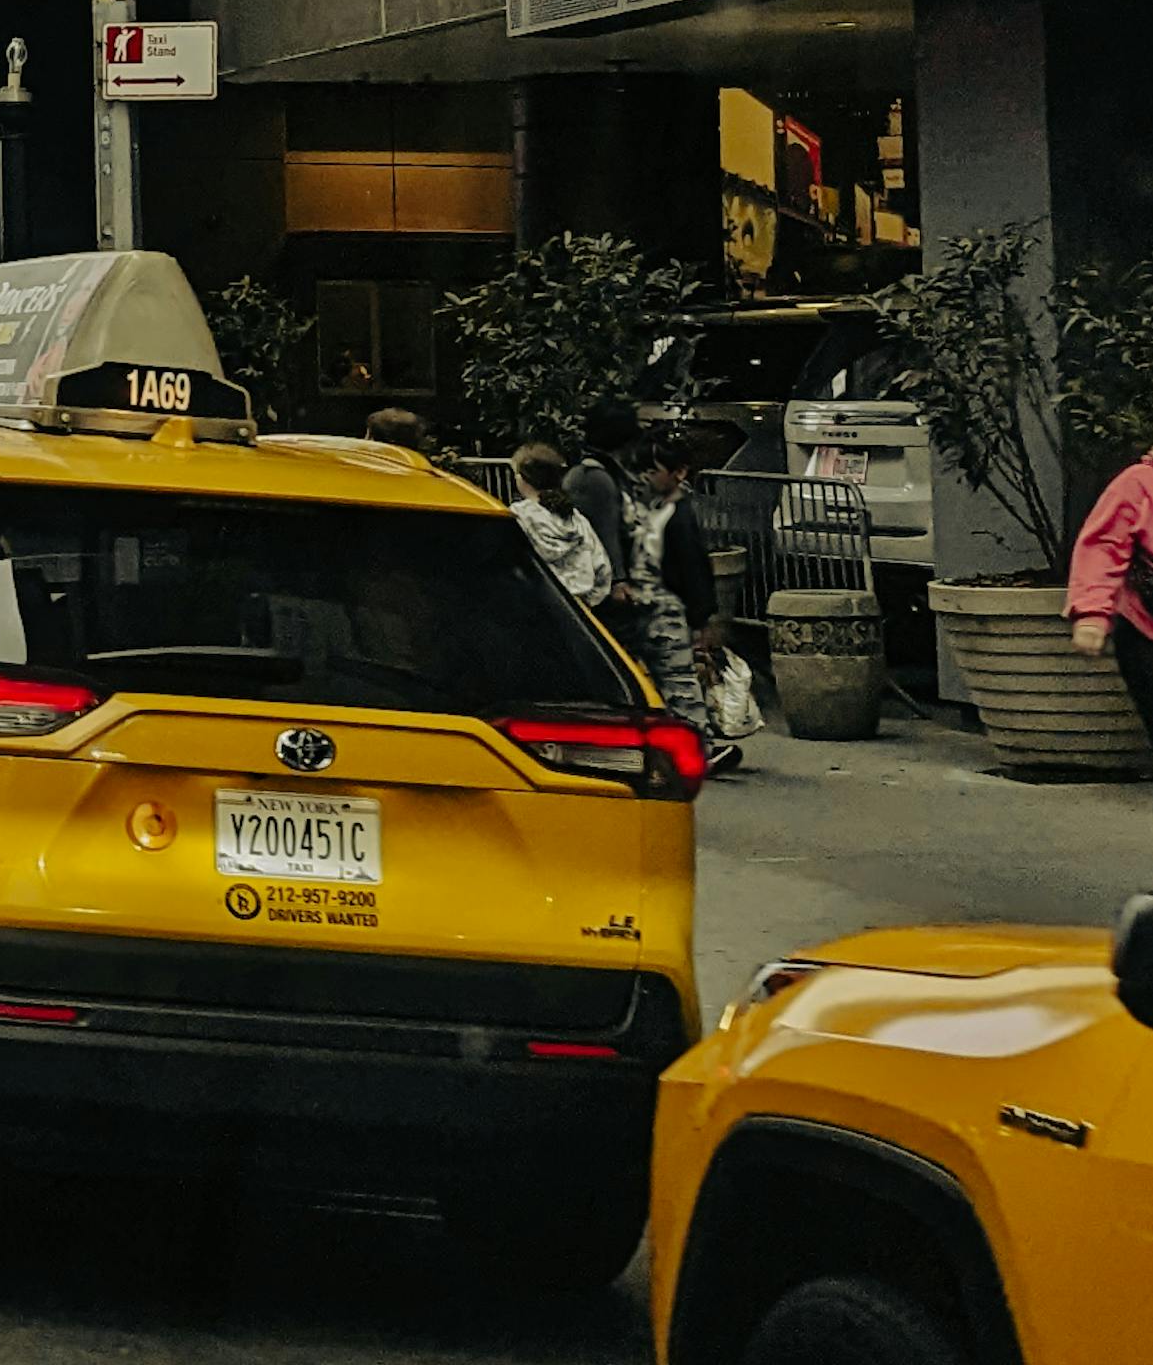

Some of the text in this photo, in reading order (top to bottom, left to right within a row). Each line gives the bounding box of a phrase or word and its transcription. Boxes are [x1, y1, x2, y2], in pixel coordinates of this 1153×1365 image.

[147, 35, 167, 44] Taxi
[147, 47, 176, 57] Stand
[127, 369, 191, 411] 1A69
[257, 798, 338, 815] NEW YORK
[231, 813, 365, 862] Y200451C
[288, 862, 314, 872] TAXI
[265, 886, 376, 907] 212-957-9200
[268, 908, 378, 927] DRIVERS WANTED
